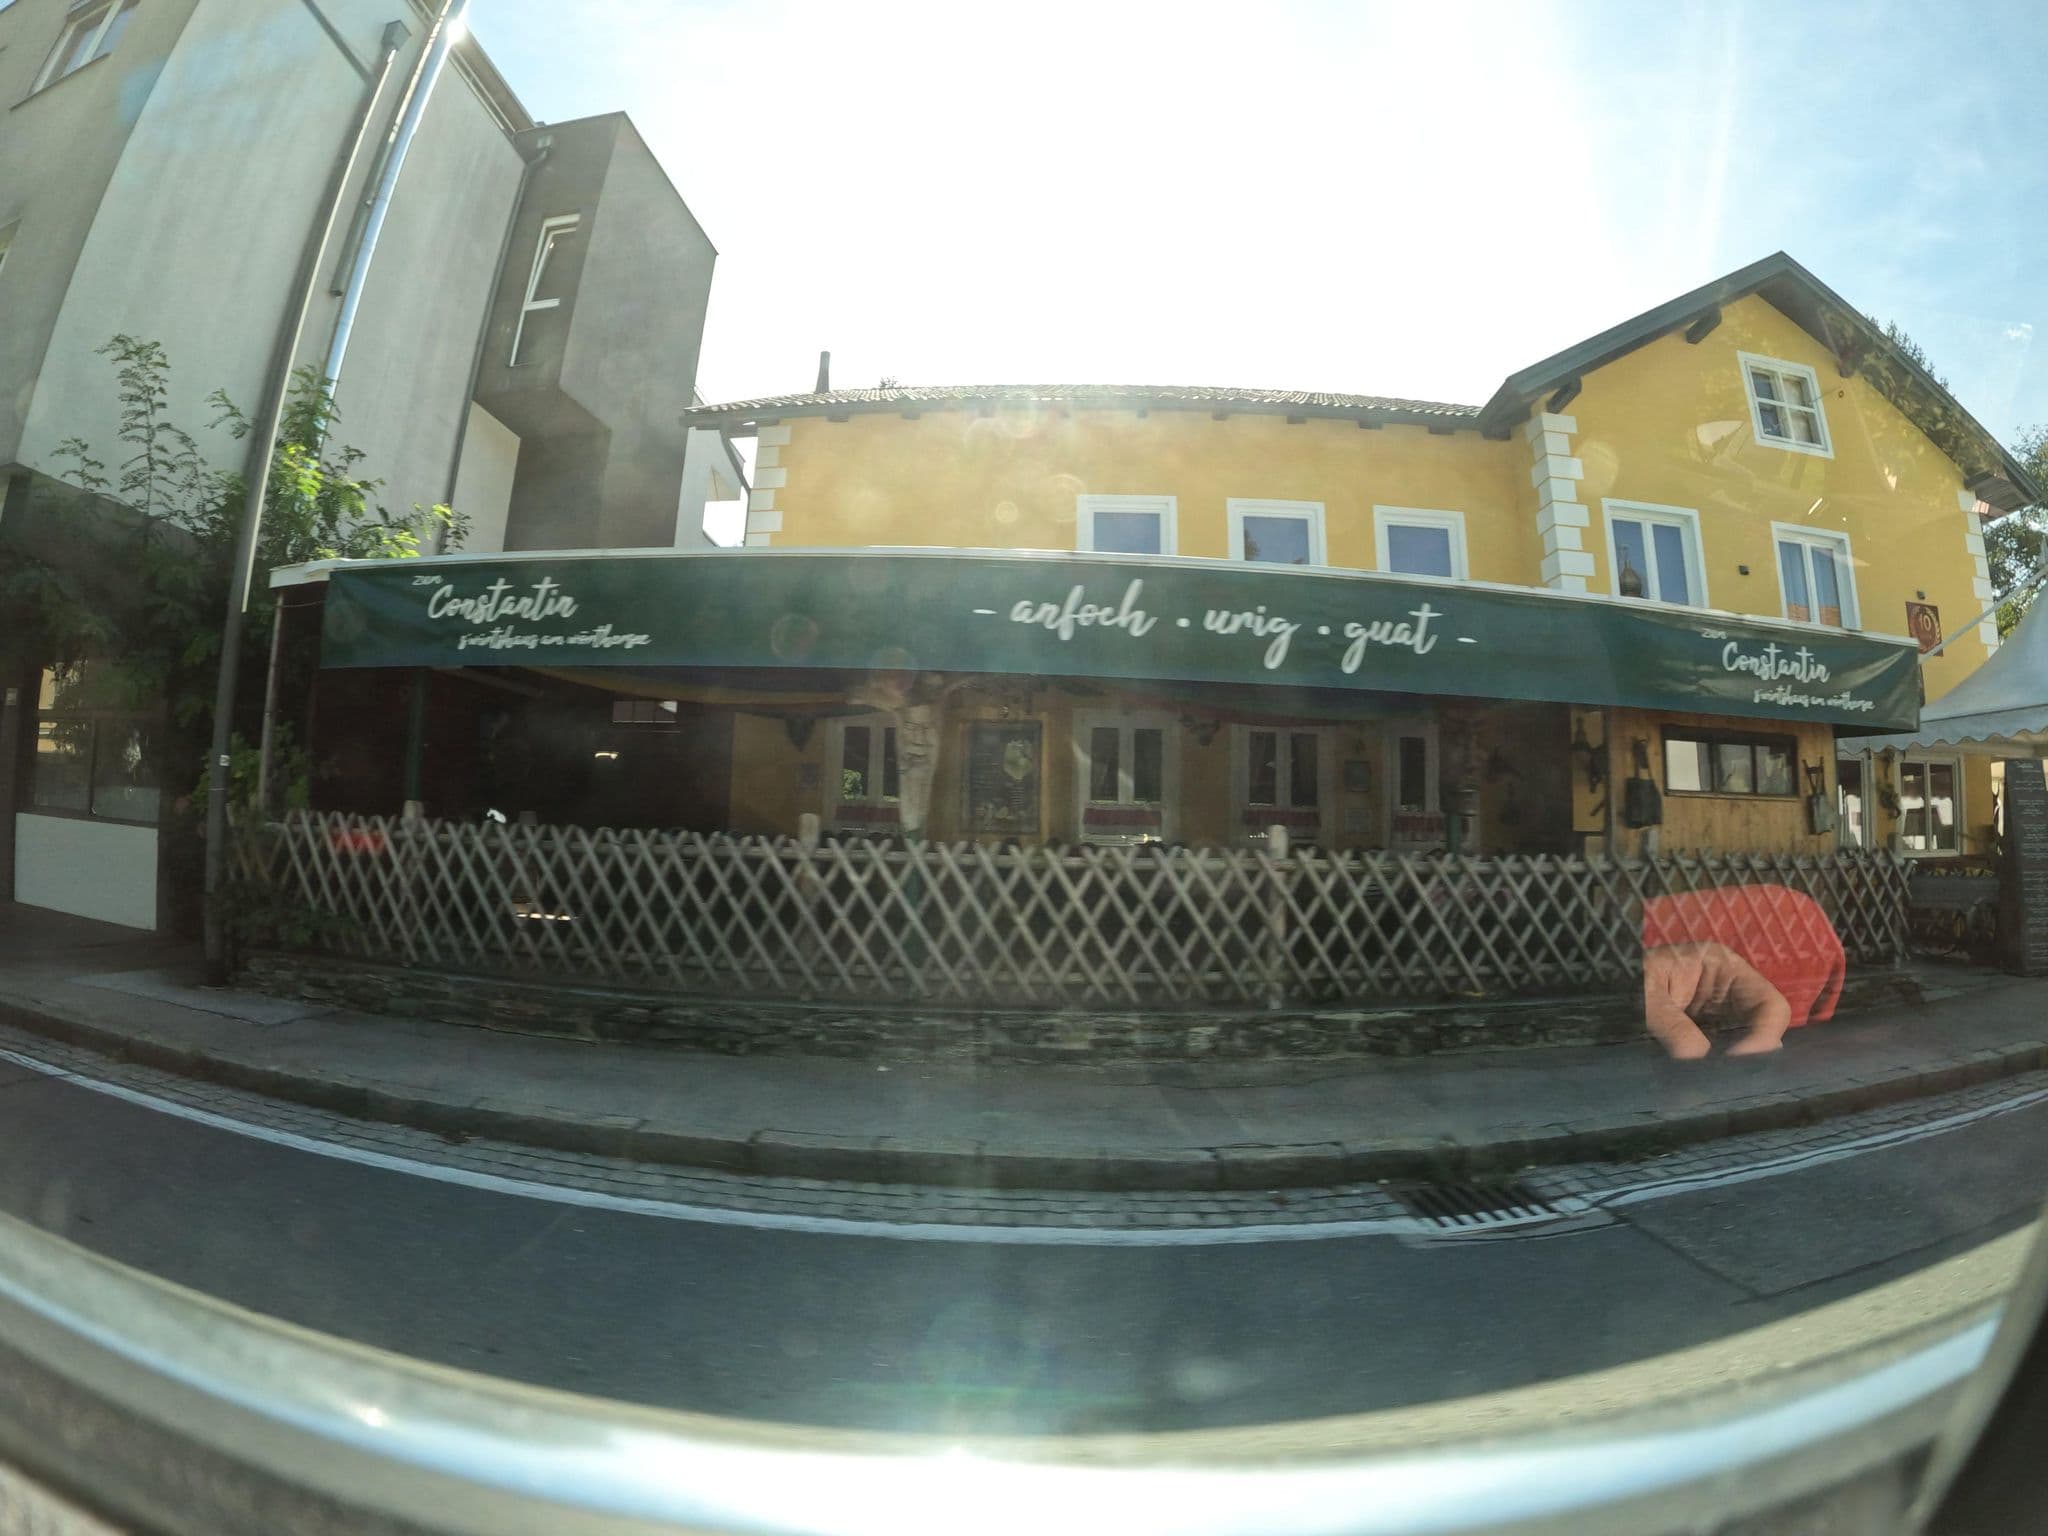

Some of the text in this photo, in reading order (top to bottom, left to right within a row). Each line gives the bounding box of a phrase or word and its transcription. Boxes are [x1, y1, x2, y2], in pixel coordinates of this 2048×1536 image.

[428, 576, 578, 623] Constantin
[1009, 579, 1443, 673] anfoch urig guat
[1723, 641, 1831, 683] Constantin
